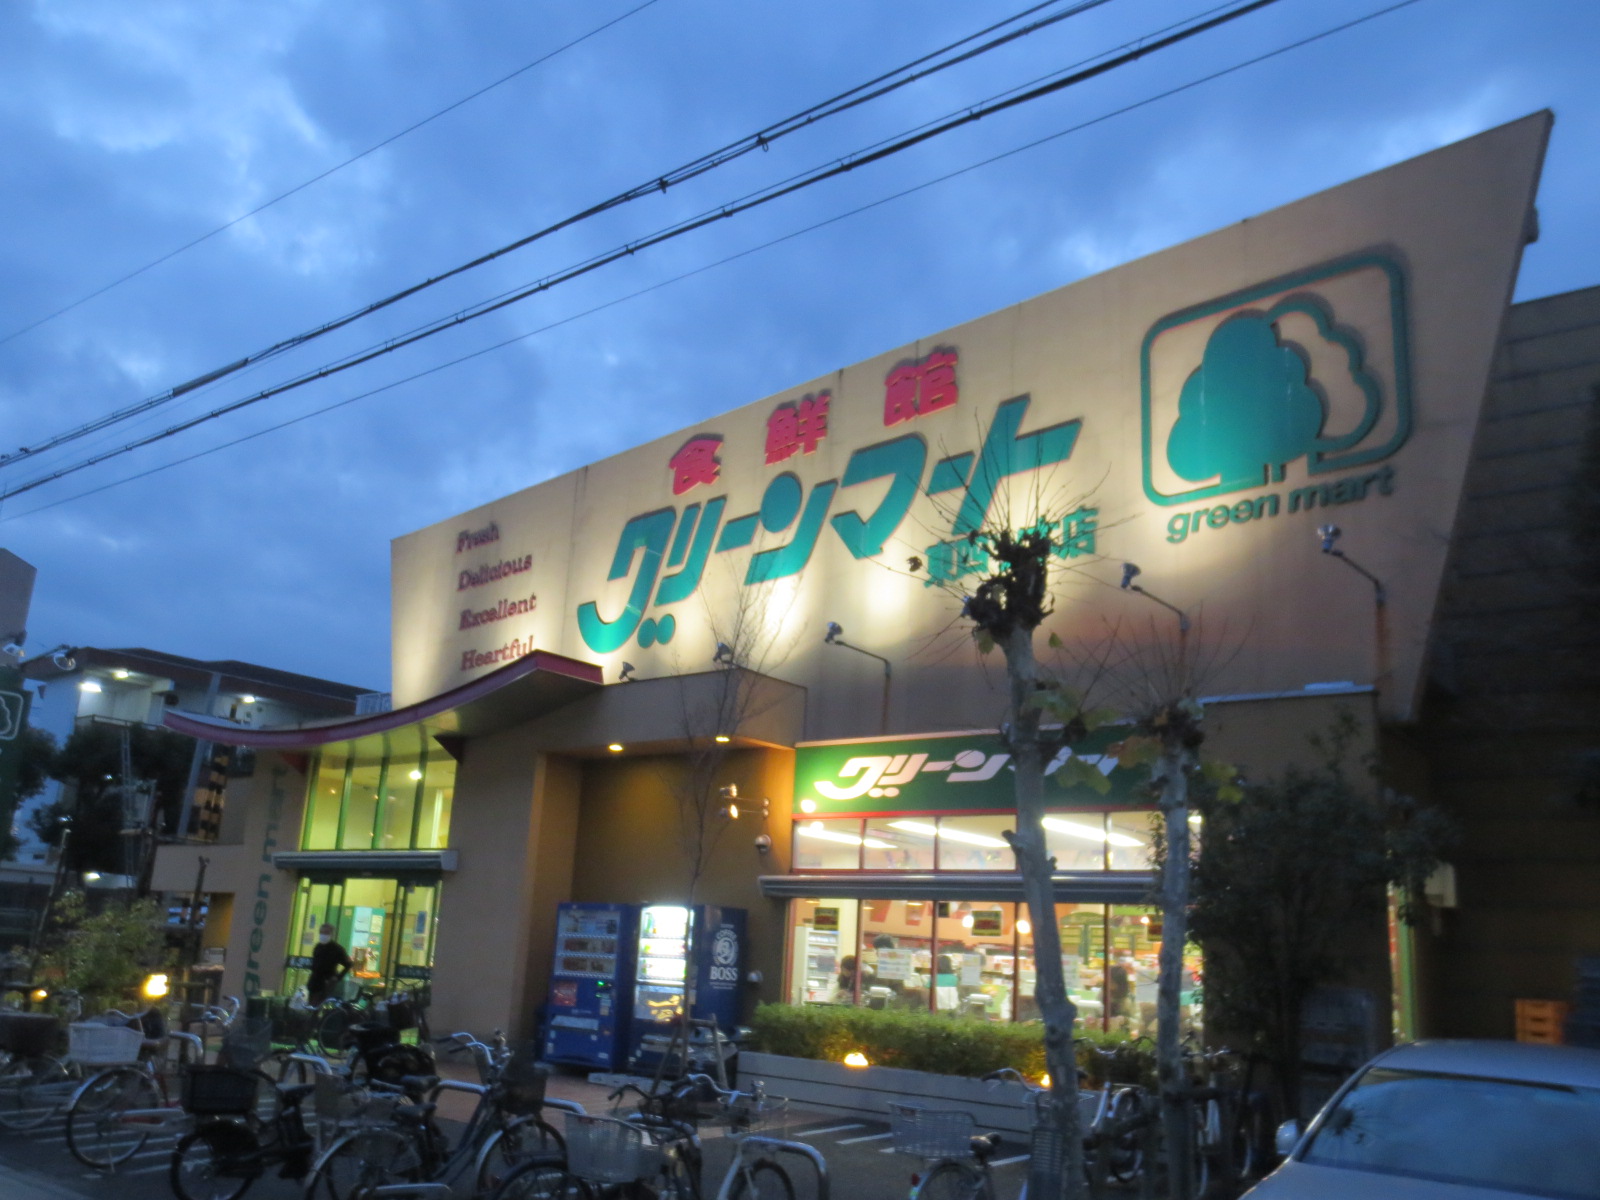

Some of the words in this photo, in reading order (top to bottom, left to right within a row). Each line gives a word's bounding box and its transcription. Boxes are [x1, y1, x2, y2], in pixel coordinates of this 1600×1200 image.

[668, 347, 960, 496] 食鮮館
[1166, 492, 1281, 544] green
[1287, 463, 1395, 514] mart
[456, 520, 500, 554] Fresh
[577, 394, 1083, 654] グリーンマート
[457, 554, 533, 591] Delicious
[458, 593, 537, 631] Excellent
[459, 635, 534, 671] Heartful
[709, 965, 739, 982] BOSS
